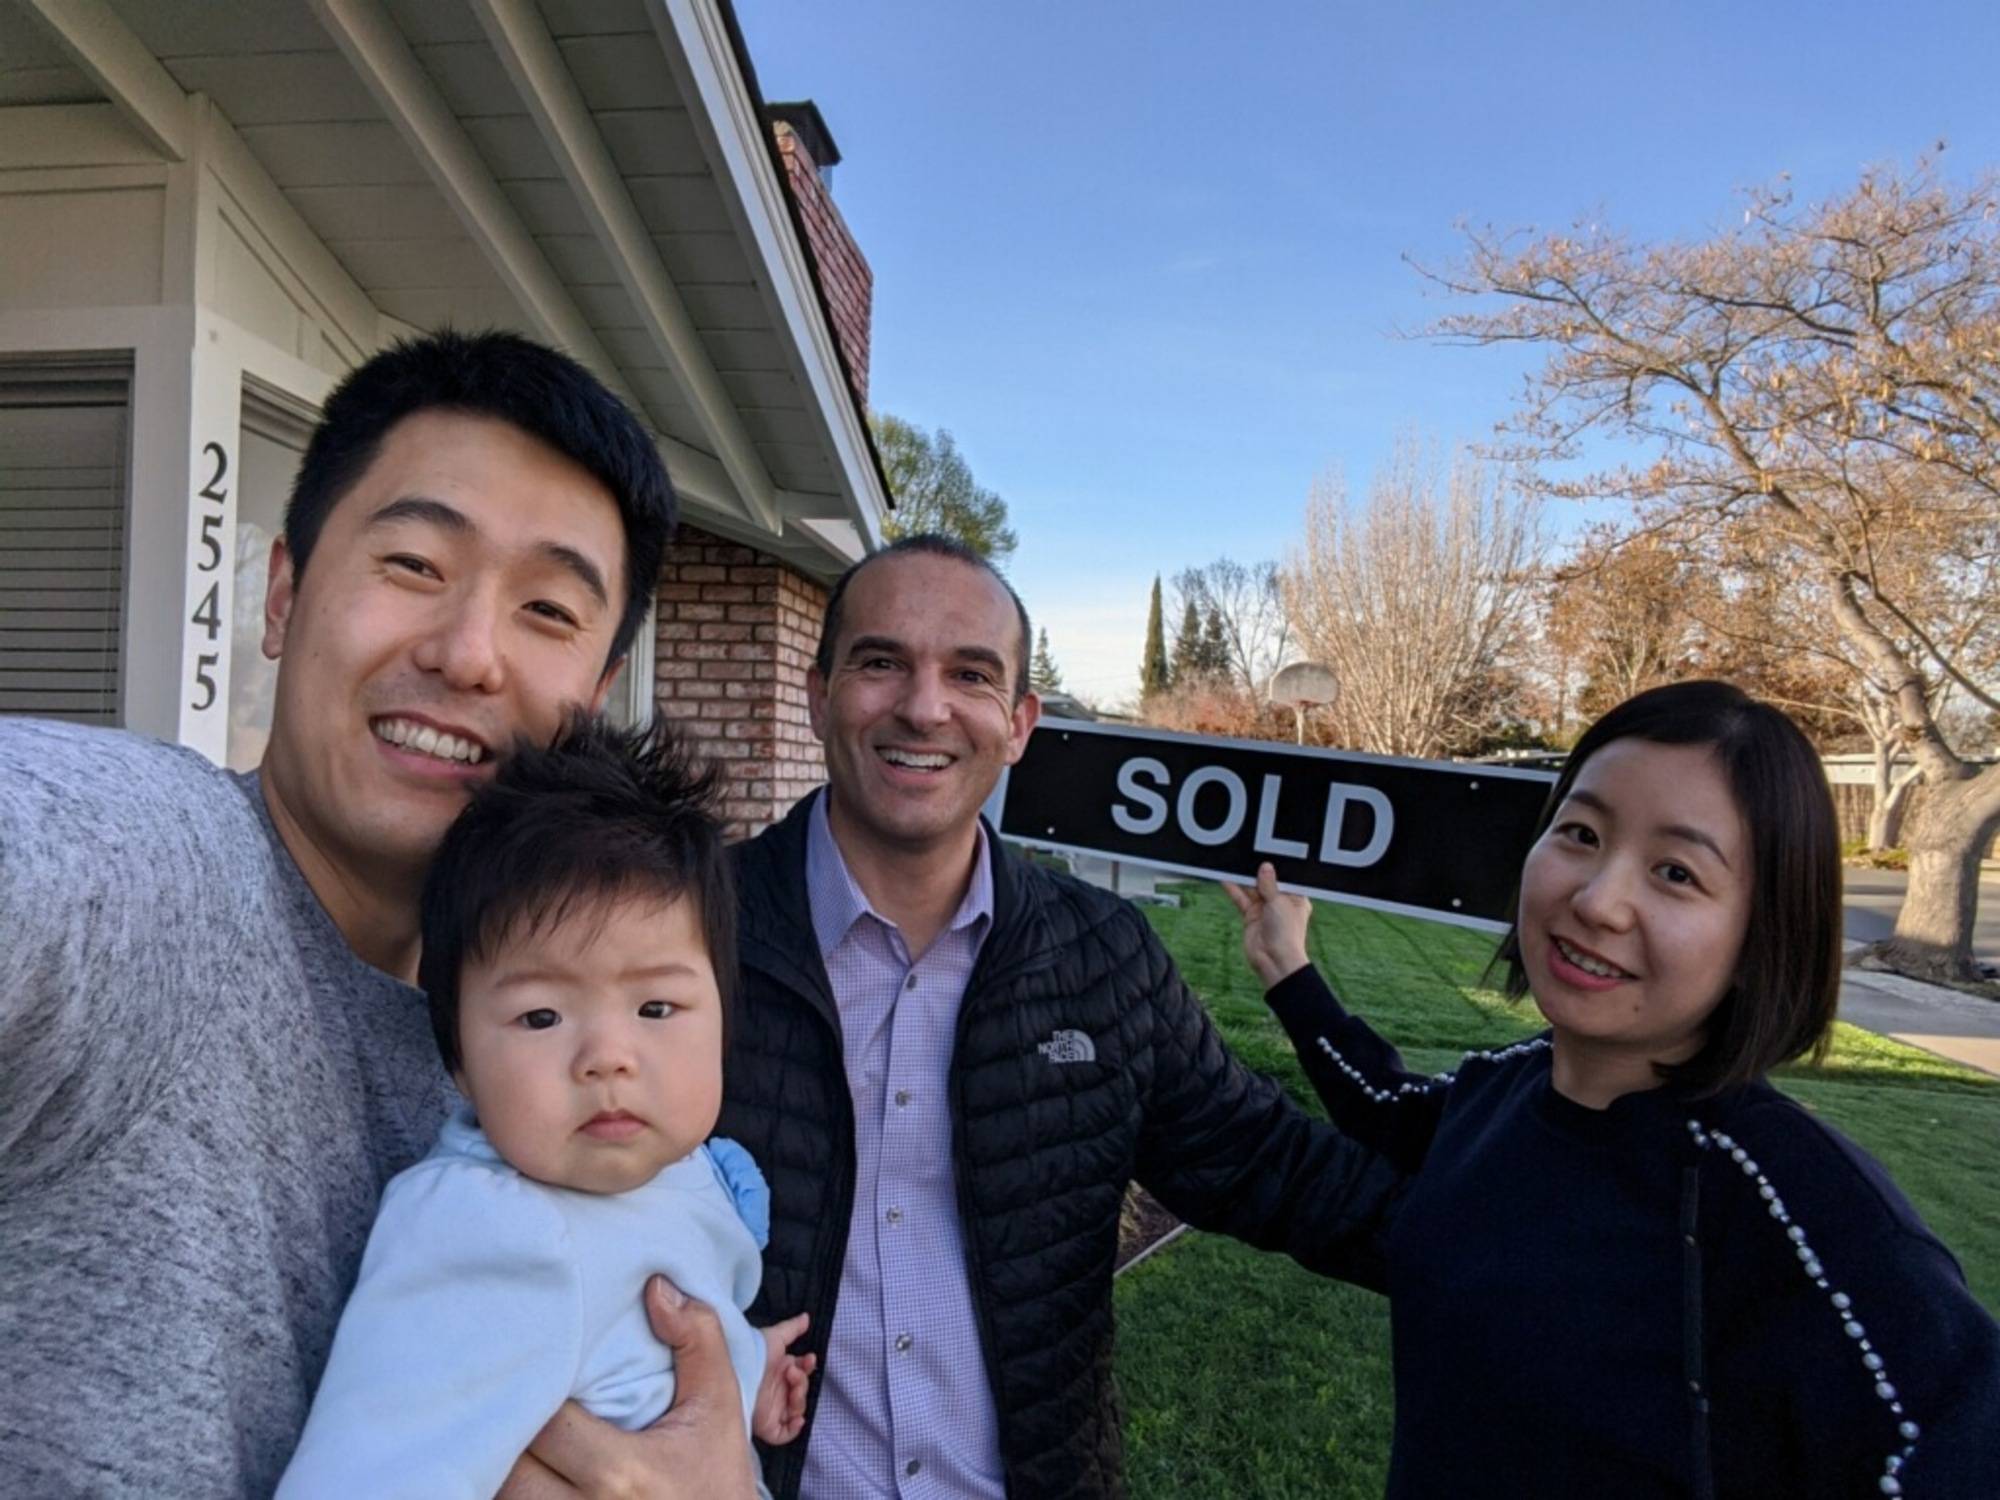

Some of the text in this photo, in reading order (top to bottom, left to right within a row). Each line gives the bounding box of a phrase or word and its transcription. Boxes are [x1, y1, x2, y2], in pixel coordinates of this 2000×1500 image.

[191, 441, 228, 711] 2545
[1111, 757, 1395, 868] SOLD
[1052, 1030, 1073, 1041] THE
[1037, 1041, 1074, 1053] NORTH
[1049, 1051, 1074, 1063] FACE
